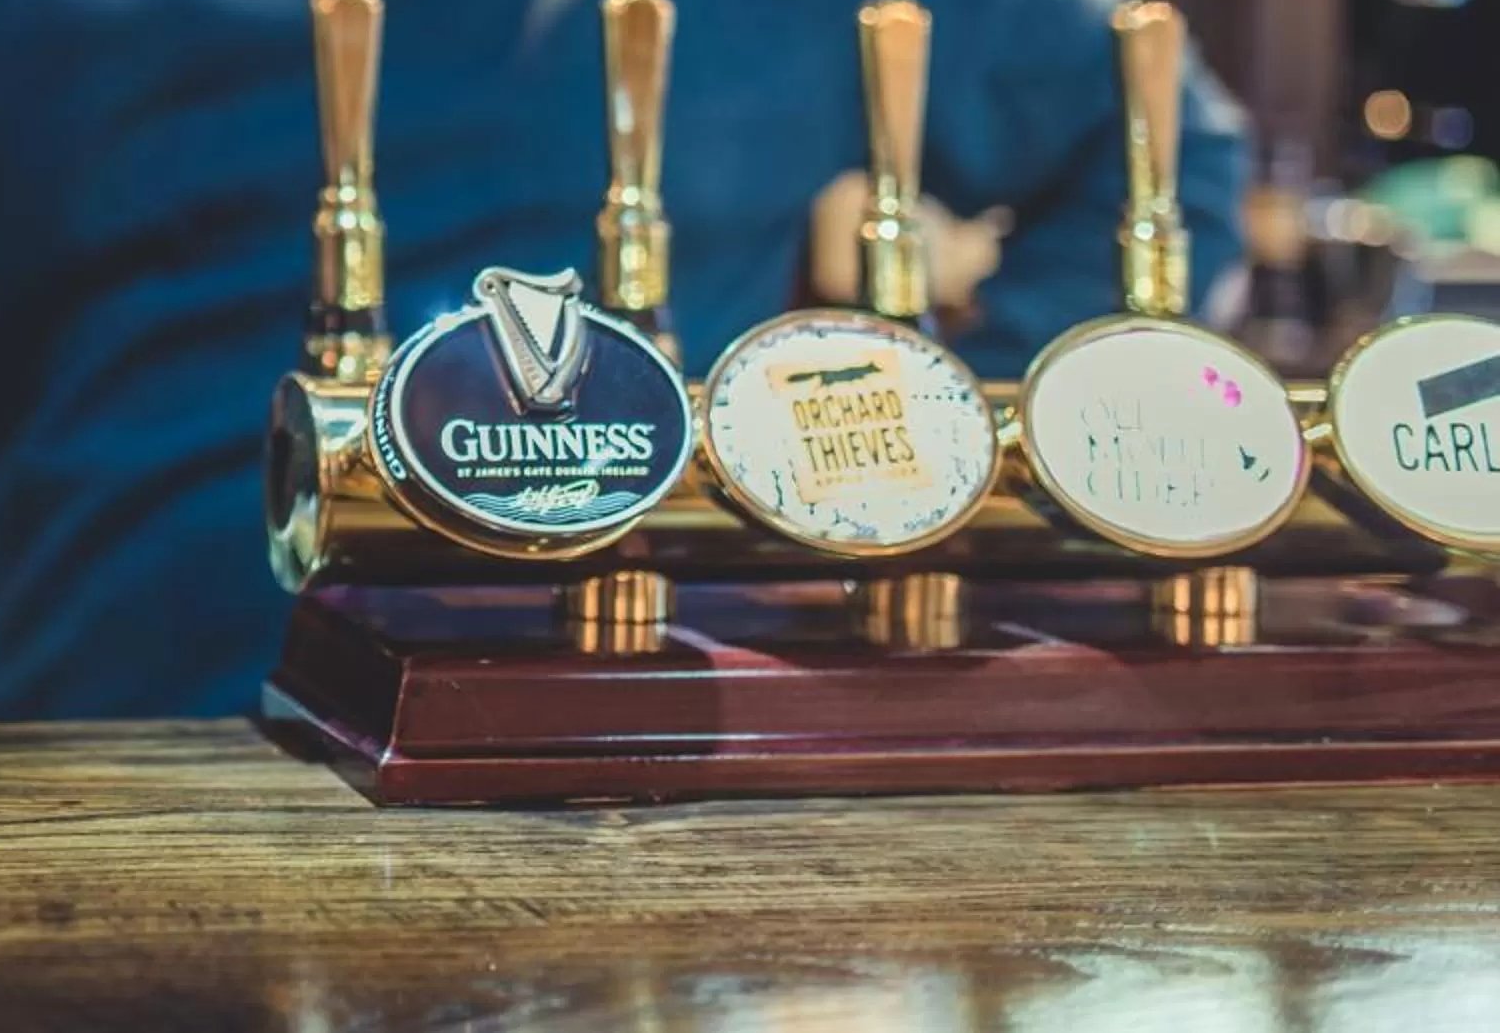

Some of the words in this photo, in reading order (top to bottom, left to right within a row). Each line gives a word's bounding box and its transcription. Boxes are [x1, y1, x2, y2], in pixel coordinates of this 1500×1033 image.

[791, 389, 902, 430] ORCHARD
[440, 418, 654, 462] GUINNESS
[802, 426, 916, 473] THIEVES
[1392, 422, 1500, 472] CARL
